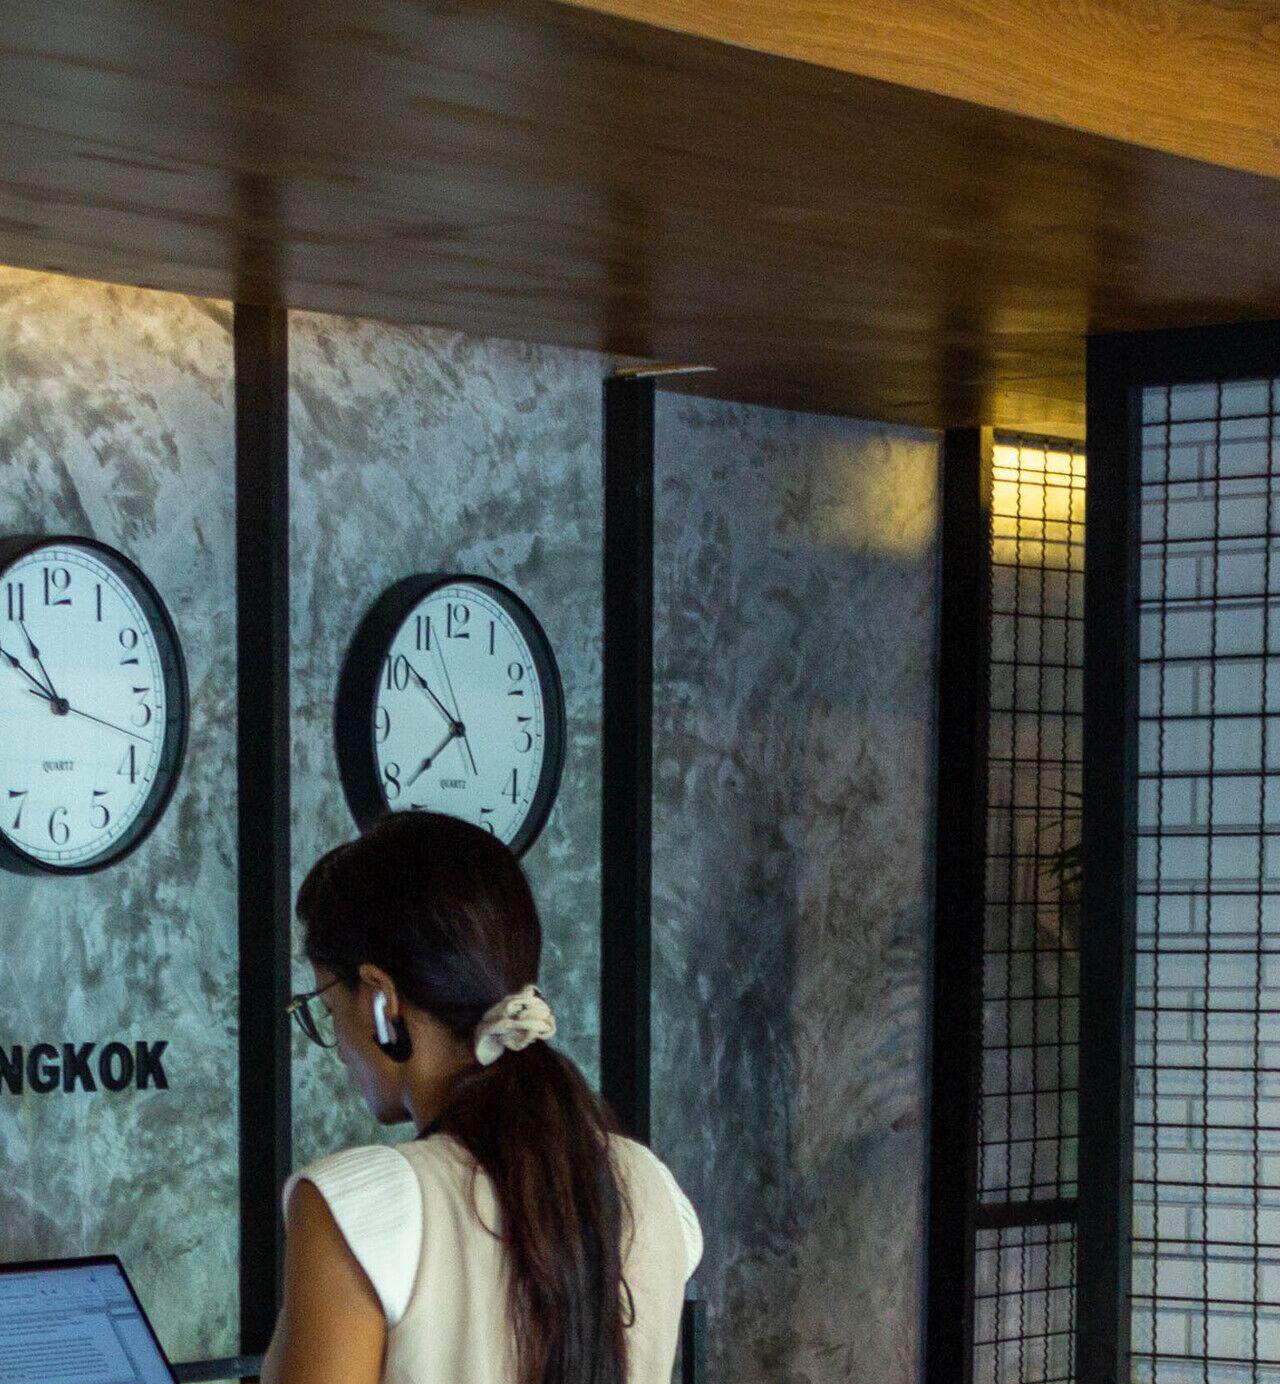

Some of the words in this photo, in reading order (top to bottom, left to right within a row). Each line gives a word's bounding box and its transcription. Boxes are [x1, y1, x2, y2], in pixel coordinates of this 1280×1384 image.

[8, 583, 25, 621] 11
[44, 567, 72, 606] 12
[96, 584, 103, 622] 1
[416, 616, 431, 651] 11
[445, 603, 470, 639] 12
[489, 621, 495, 655] 1
[119, 628, 138, 665] 2
[386, 654, 410, 691] 10
[507, 662, 524, 696] 2
[132, 687, 152, 728] 3
[375, 706, 390, 744] 9
[515, 715, 533, 753] 3
[43, 761, 73, 773] QUARTZ
[117, 745, 140, 784] 4
[384, 762, 400, 800] 8
[502, 768, 521, 804] 4
[8, 790, 29, 829] 7
[48, 806, 70, 845] 6
[90, 790, 110, 829] 5
